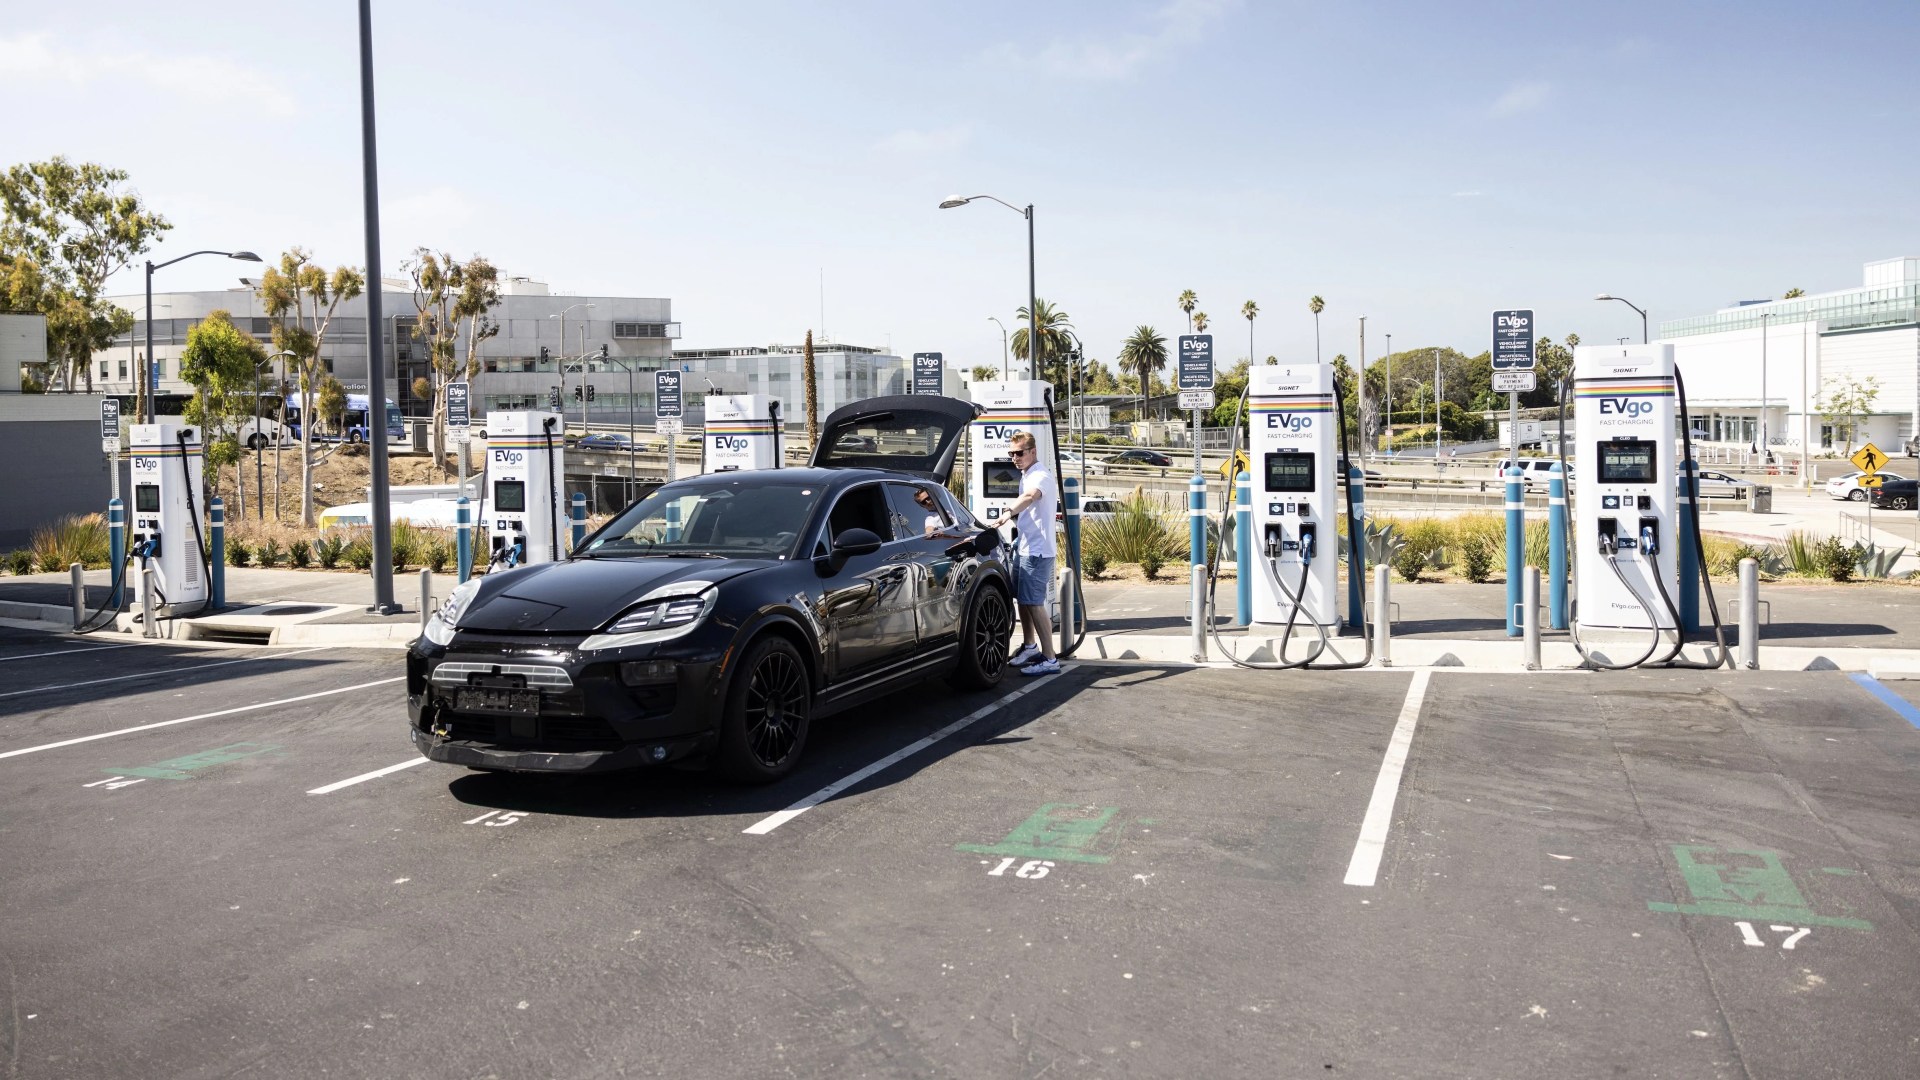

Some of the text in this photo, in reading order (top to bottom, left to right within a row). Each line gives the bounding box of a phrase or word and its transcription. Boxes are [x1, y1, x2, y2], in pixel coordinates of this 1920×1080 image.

[1498, 316, 1528, 328] EVgo
[1183, 341, 1208, 351] EVgo
[917, 358, 938, 367] EVgo
[659, 376, 677, 385] EVgo
[450, 388, 465, 396] EVgo
[1600, 398, 1653, 418] EVgo
[1268, 414, 1312, 432] EVgo
[716, 436, 748, 452] EVgo
[495, 450, 522, 464] EVgo
[136, 458, 157, 471] EVgo
[462, 810, 529, 826] 15
[988, 858, 1055, 879] 16
[1734, 922, 1811, 950] 17
